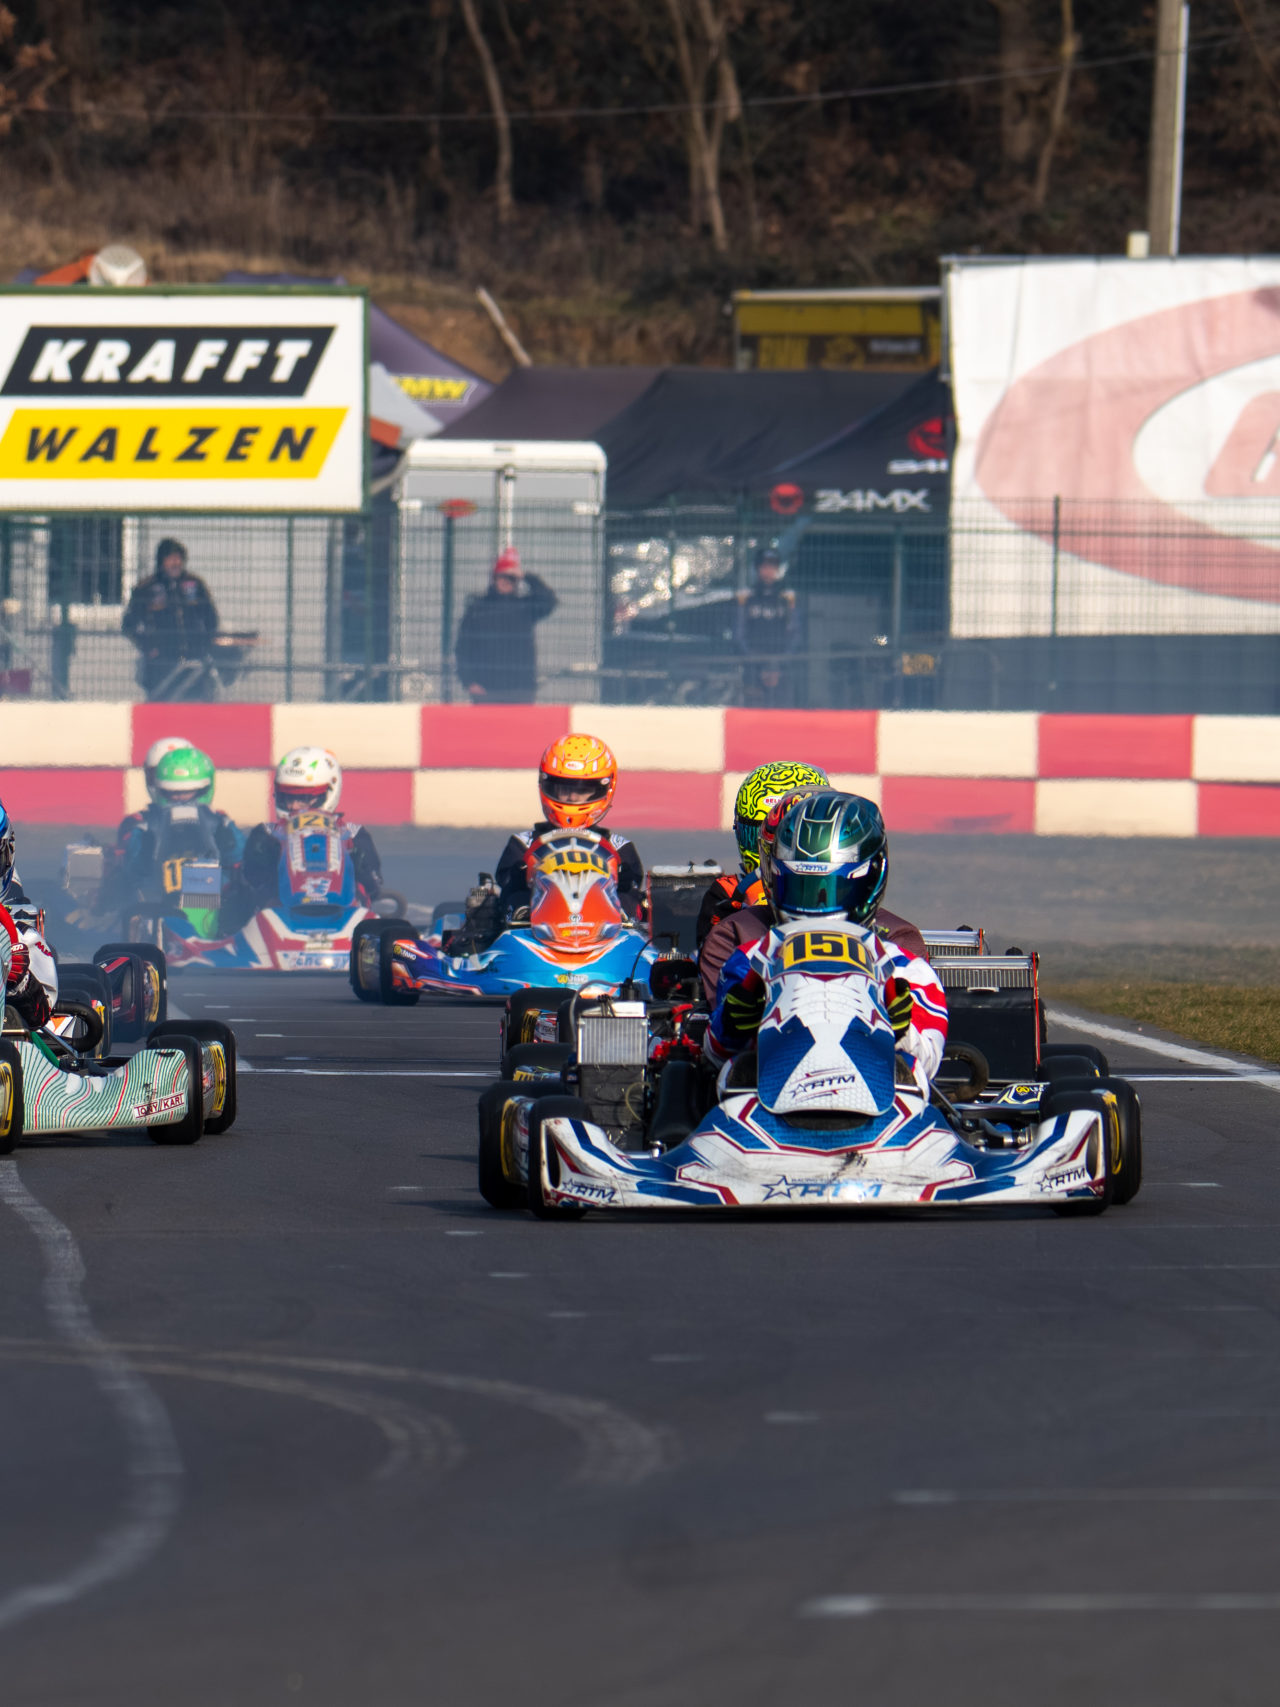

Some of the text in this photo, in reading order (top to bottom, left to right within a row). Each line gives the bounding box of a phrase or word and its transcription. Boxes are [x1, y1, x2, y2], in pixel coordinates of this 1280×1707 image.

[29, 338, 314, 383] KRAFFT
[25, 426, 316, 463] WALZEN
[1052, 1168, 1086, 1187] RTM
[574, 1185, 617, 1203] RTM
